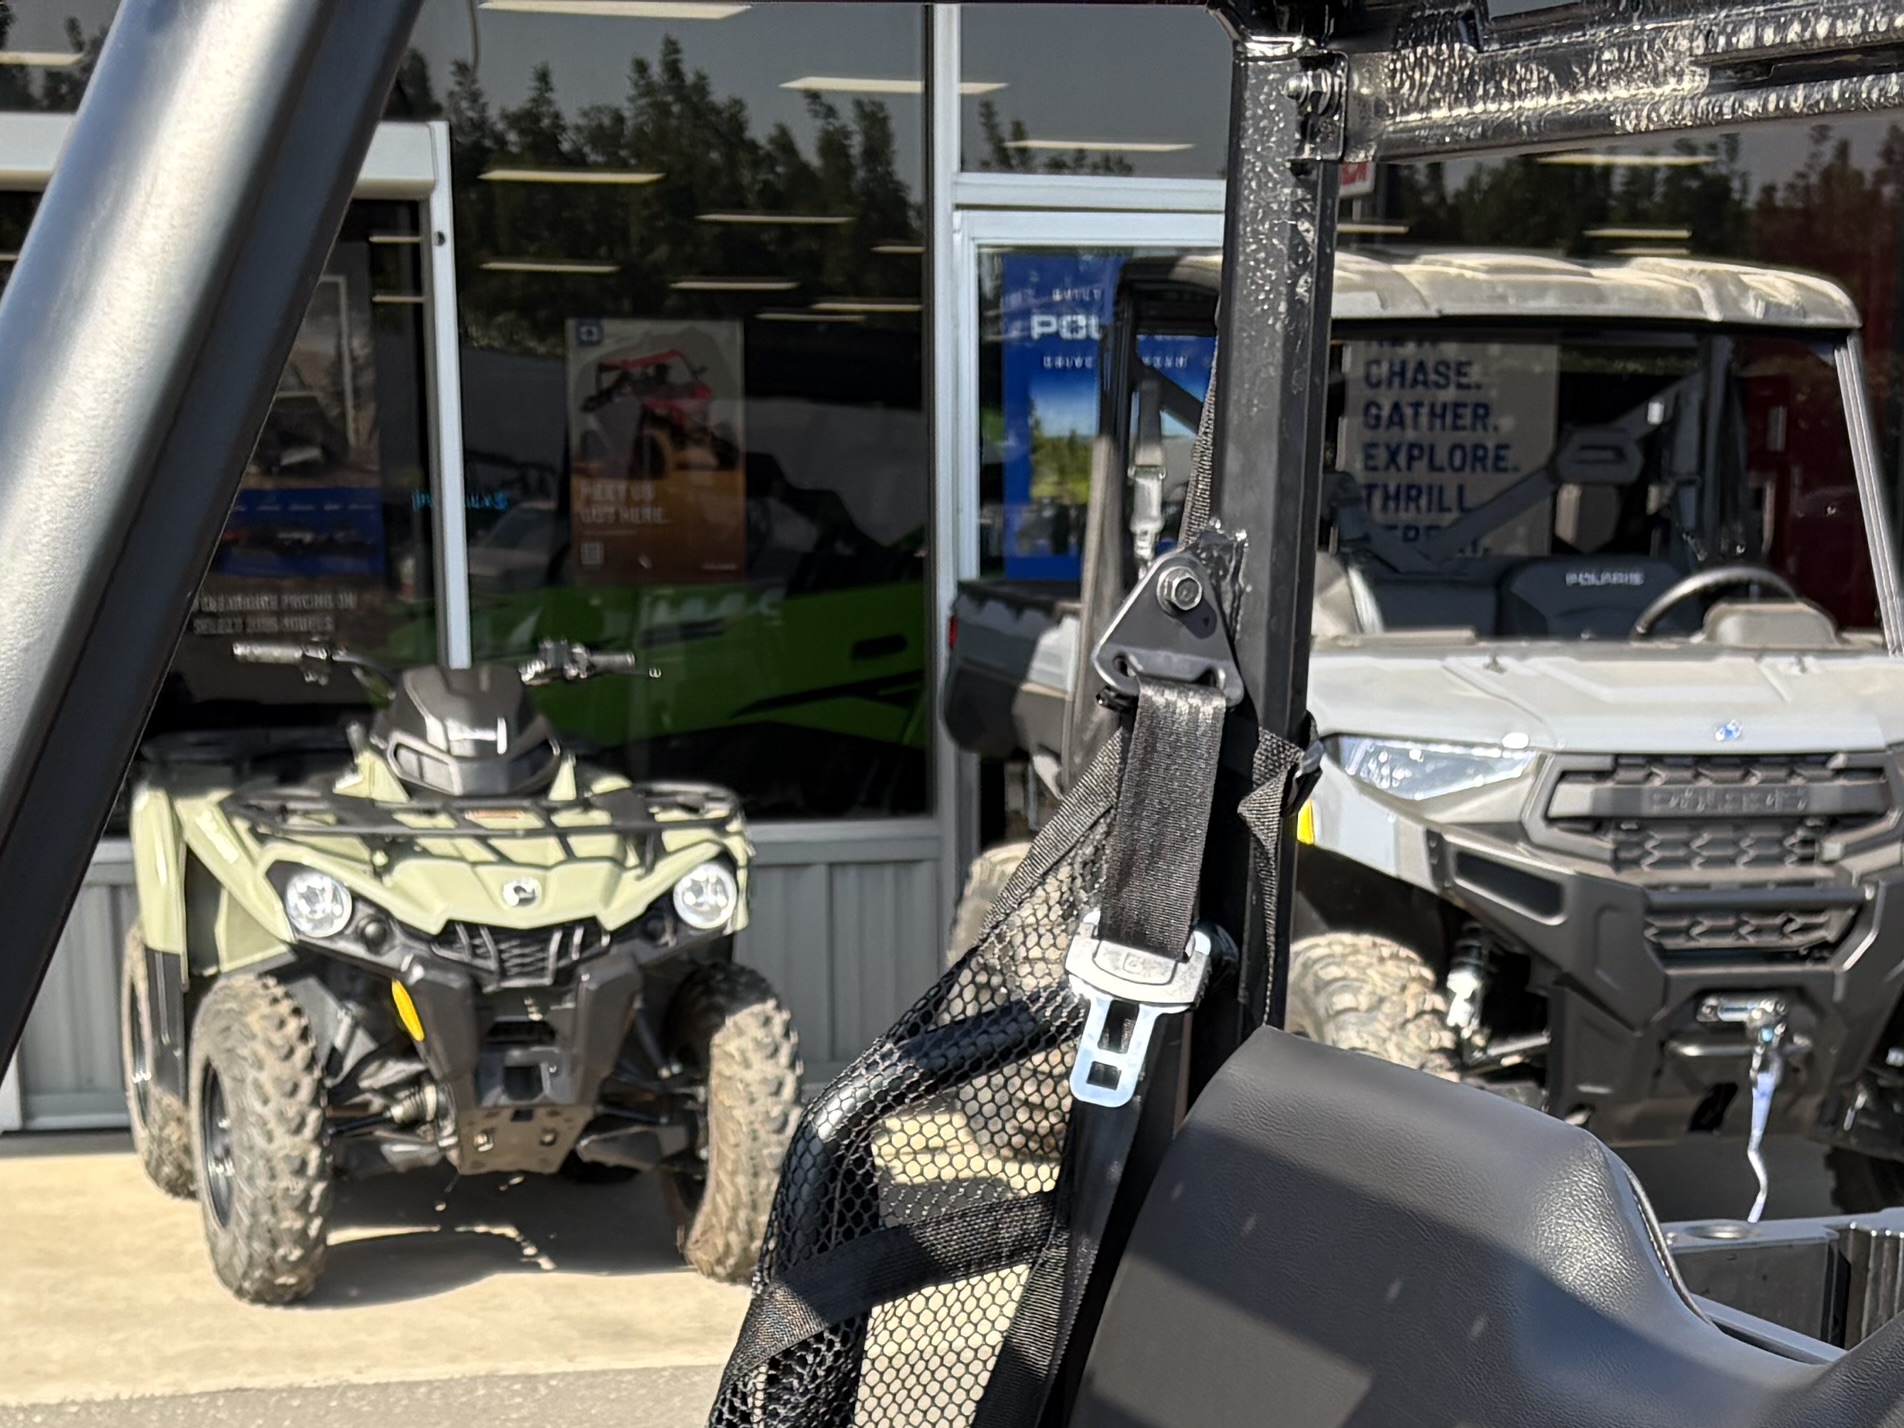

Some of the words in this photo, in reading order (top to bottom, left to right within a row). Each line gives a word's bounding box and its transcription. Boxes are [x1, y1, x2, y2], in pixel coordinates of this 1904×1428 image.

[1364, 359, 1483, 390] CHASE.
[1363, 401, 1499, 432] GATHER.
[1363, 443, 1521, 473] EXPLORE.
